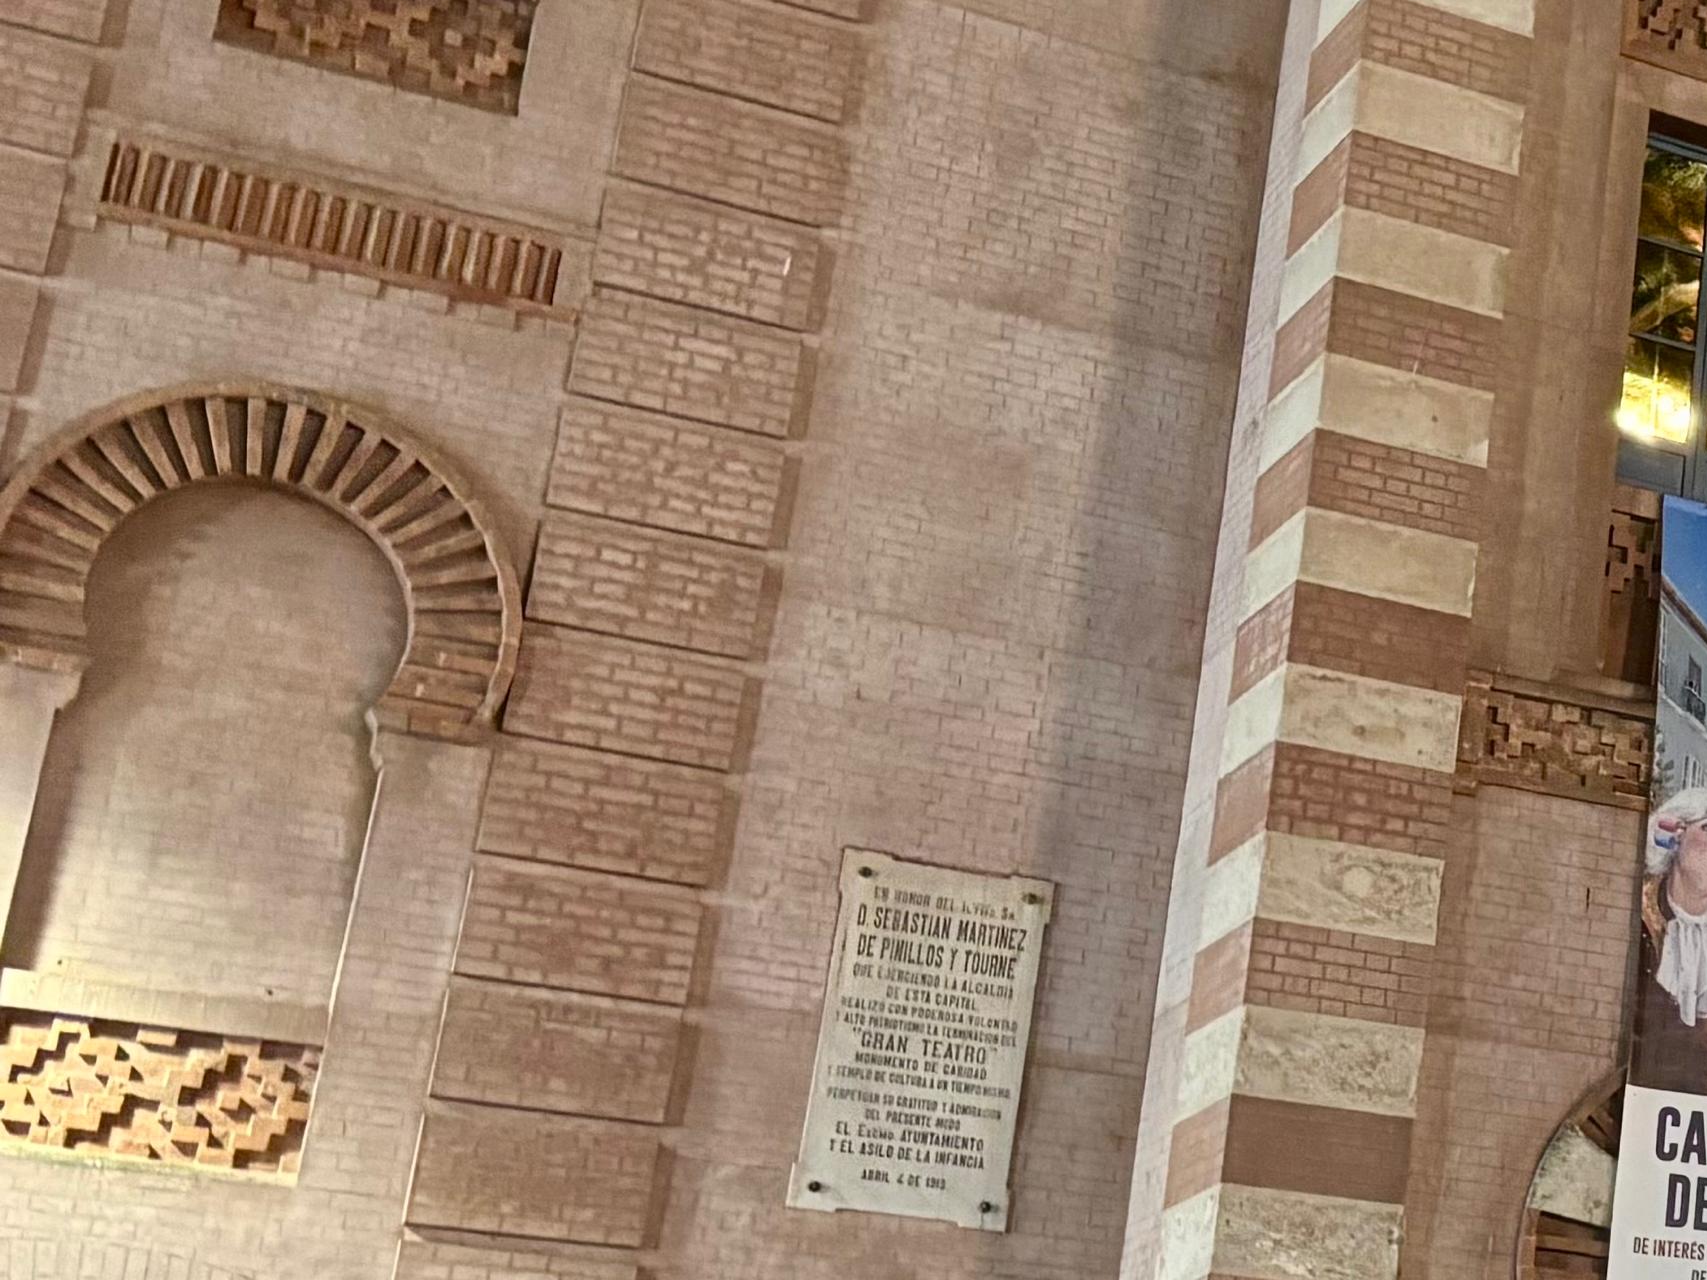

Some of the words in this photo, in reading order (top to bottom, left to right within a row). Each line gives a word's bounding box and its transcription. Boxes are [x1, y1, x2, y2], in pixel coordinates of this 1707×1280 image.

[856, 902, 871, 927] D.
[872, 905, 951, 940] SEBASTIAN
[956, 919, 1027, 952] MARTINEZ
[856, 932, 876, 957] DE
[879, 936, 944, 968] PINILLOS
[948, 947, 958, 970] Y
[885, 985, 900, 1000] DE
[904, 987, 931, 1004] ESTA
[923, 1060, 938, 1073] DE
[834, 1120, 851, 1136] EL
[899, 1128, 984, 1153] AYUNTAMIENTO
[839, 1138, 856, 1154] EL
[859, 1141, 894, 1159] ASILO
[896, 1146, 912, 1161] DE
[915, 1148, 931, 1163] LA
[933, 1150, 985, 1170] INFANCIA
[860, 1167, 891, 1183] ABRIL
[1633, 1236, 1648, 1255] DE
[1653, 1239, 1705, 1261] INTERÉS
